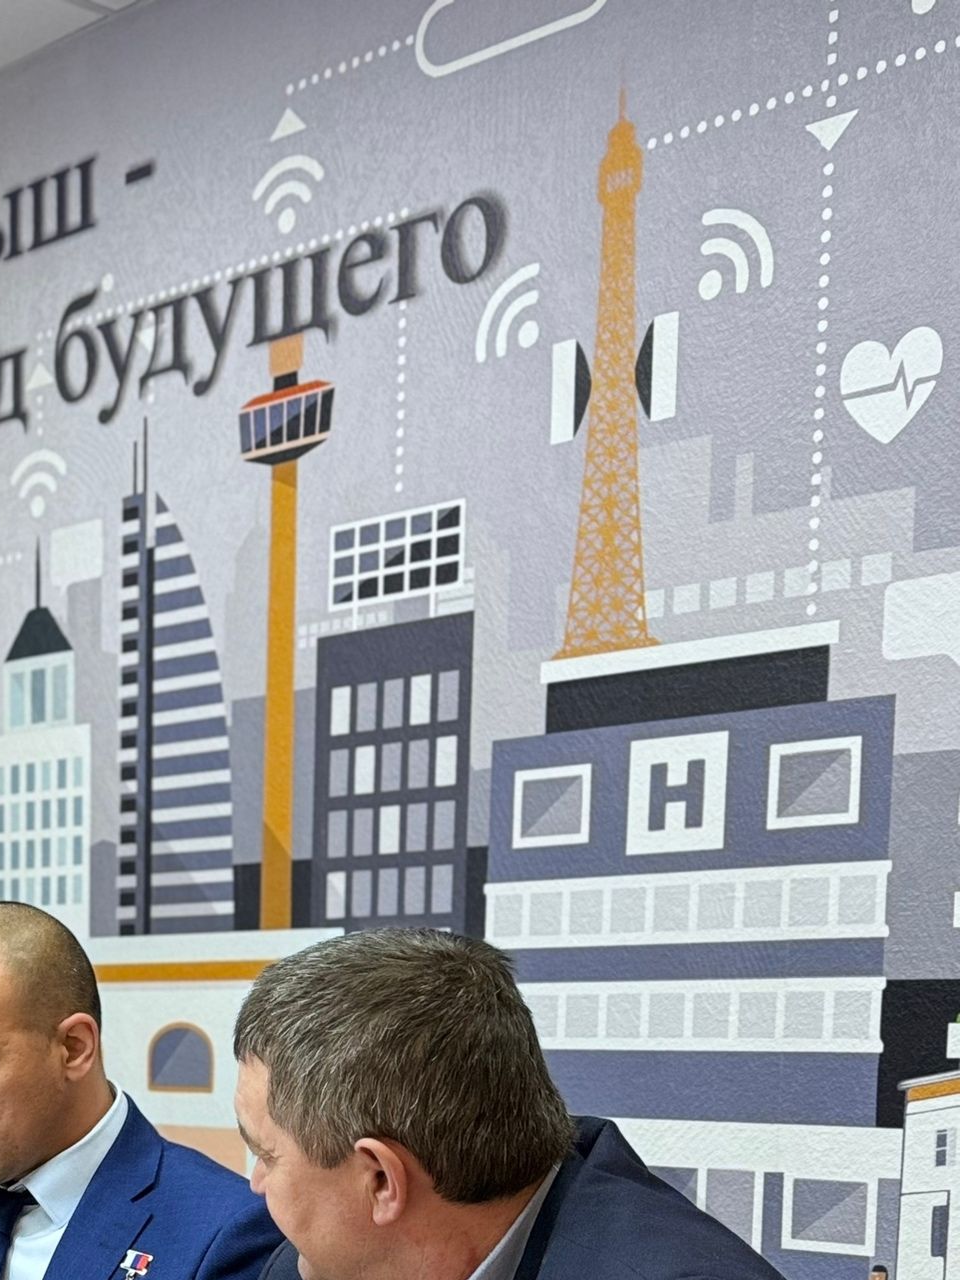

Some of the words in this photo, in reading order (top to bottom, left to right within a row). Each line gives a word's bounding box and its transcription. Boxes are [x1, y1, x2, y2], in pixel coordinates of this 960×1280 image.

[125, 161, 155, 185] -
[55, 194, 509, 425] будущего
[648, 758, 706, 832] H
